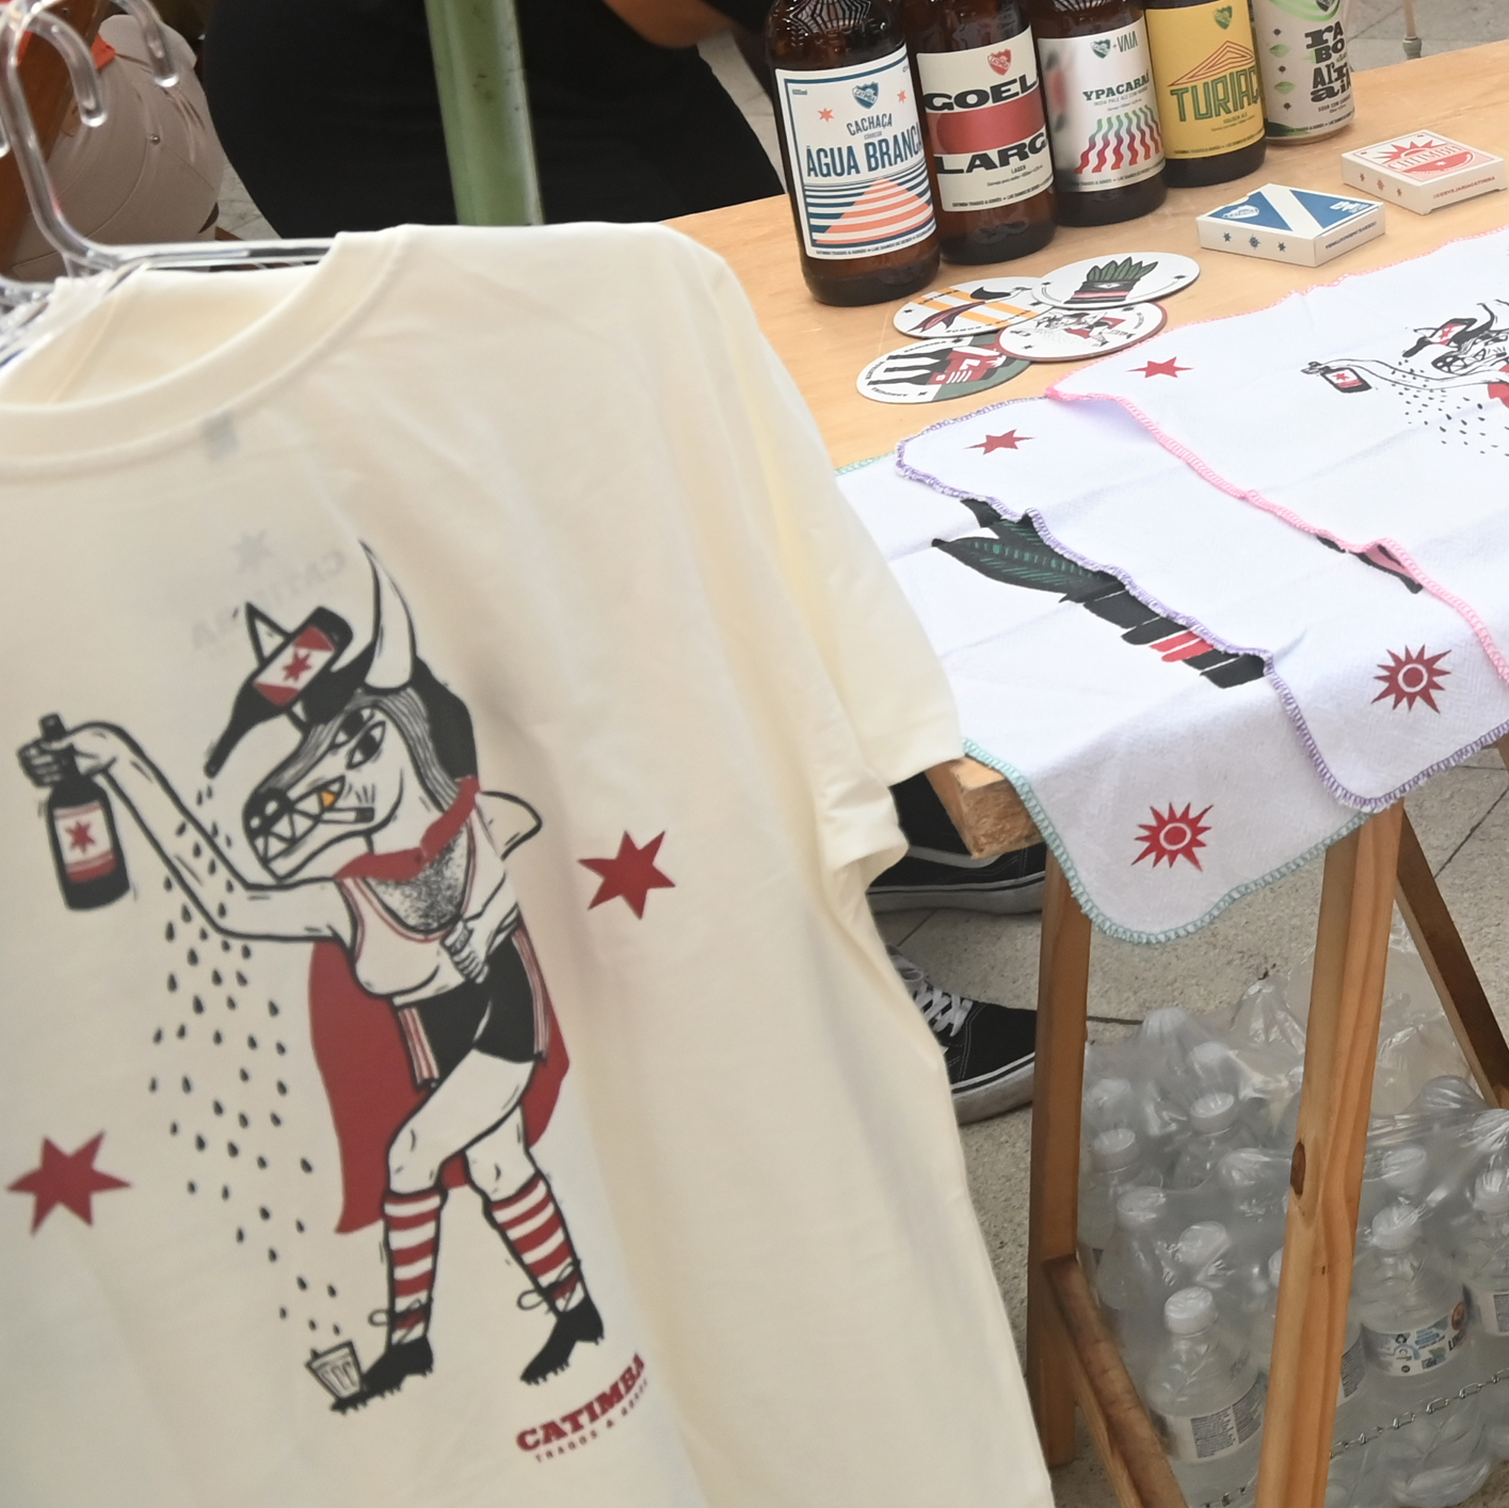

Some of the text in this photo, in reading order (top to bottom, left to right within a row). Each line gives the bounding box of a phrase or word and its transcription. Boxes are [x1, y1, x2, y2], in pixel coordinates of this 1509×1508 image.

[1083, 69, 1150, 102] YPACARAÍ
[846, 113, 893, 137] CACHAÇA
[806, 145, 861, 178] ÁGUA
[516, 1351, 645, 1453] CATIMBA
